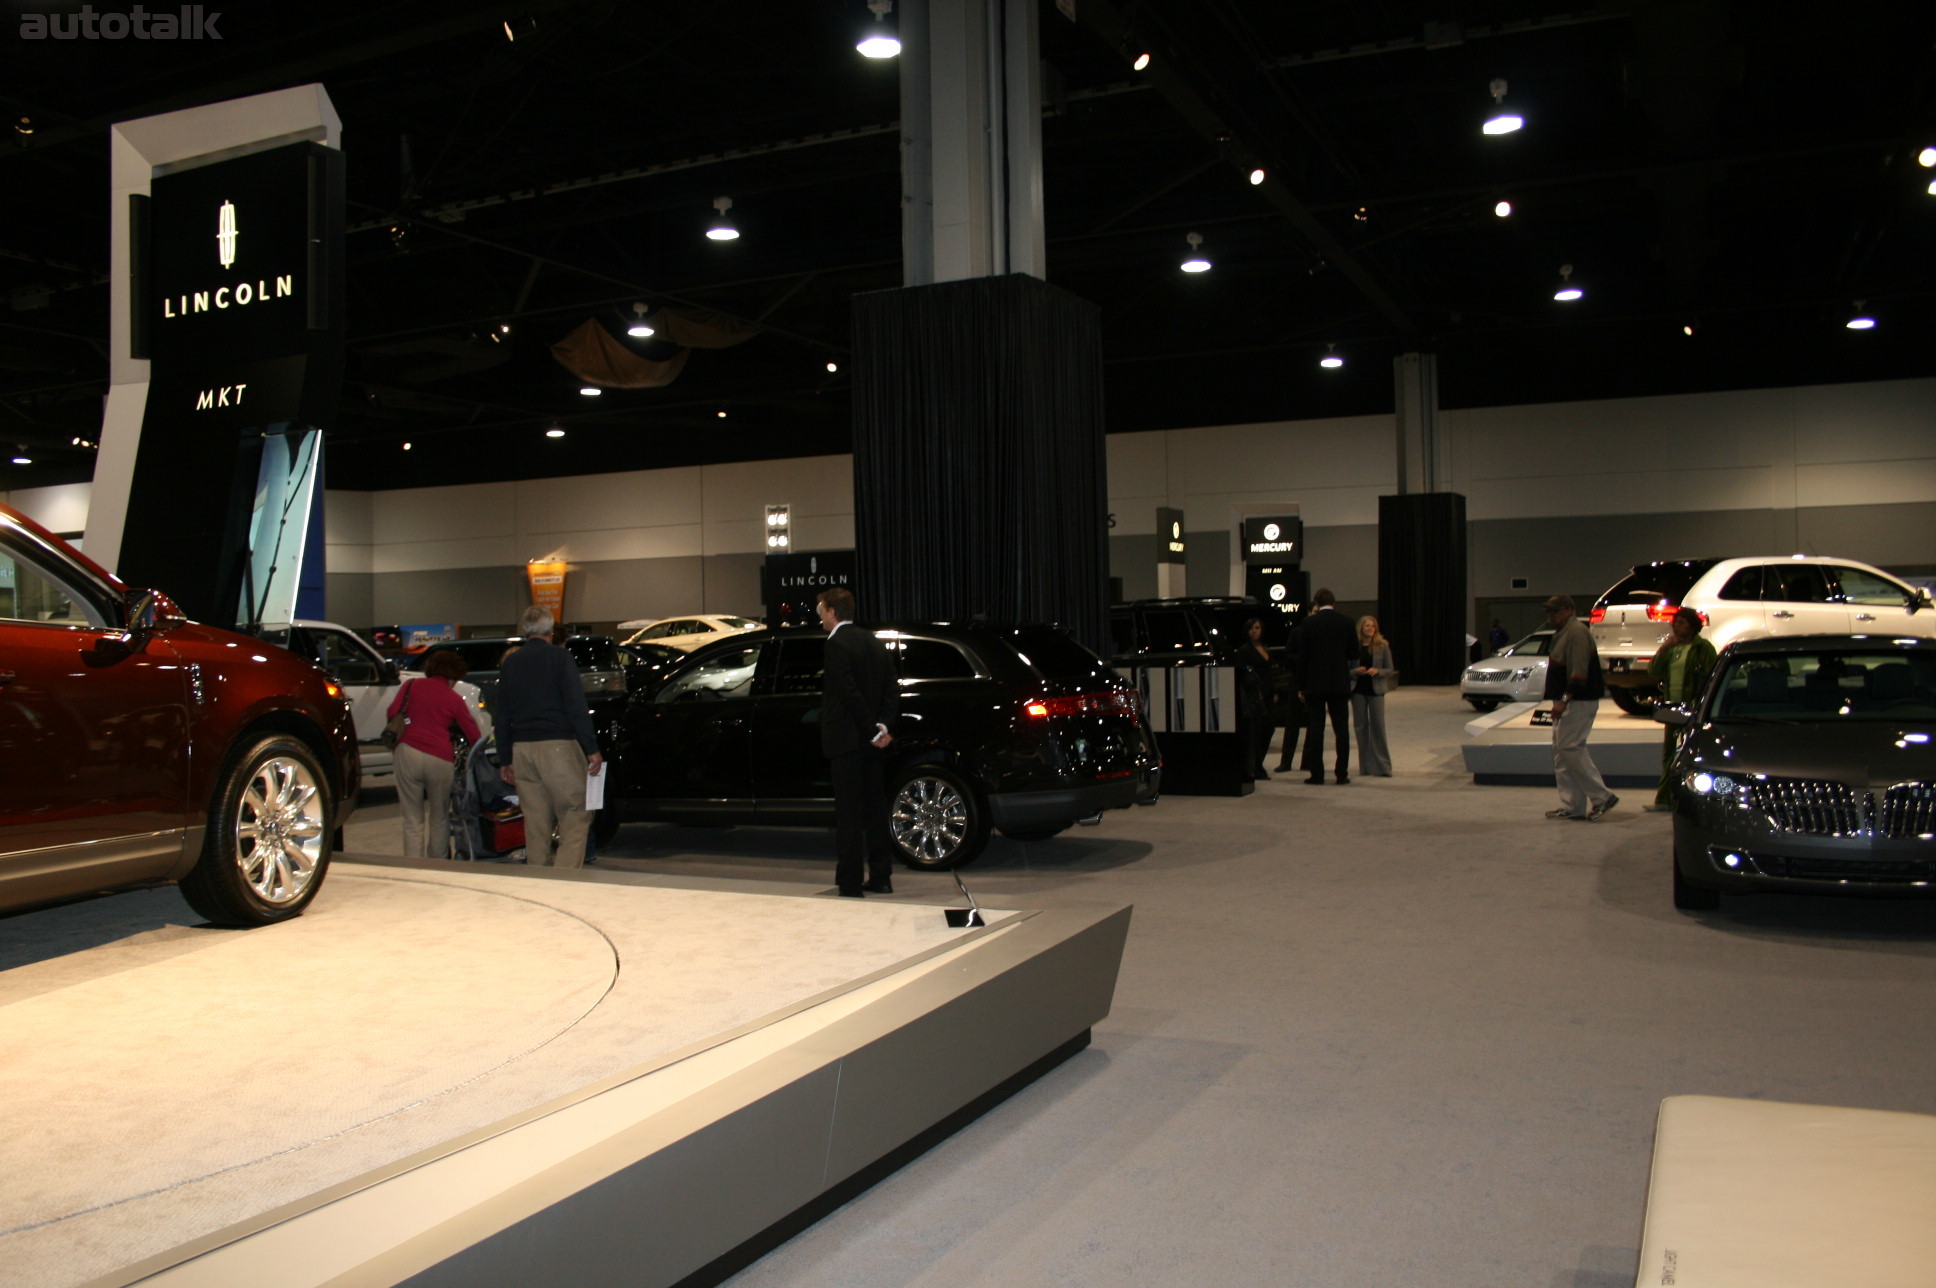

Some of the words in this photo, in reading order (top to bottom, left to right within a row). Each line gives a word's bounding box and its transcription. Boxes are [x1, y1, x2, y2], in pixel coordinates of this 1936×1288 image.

[164, 275, 292, 318] LINCOLN
[196, 384, 247, 411] MKT
[1250, 542, 1293, 553] MERCURY
[781, 575, 848, 587] LINCOLN
